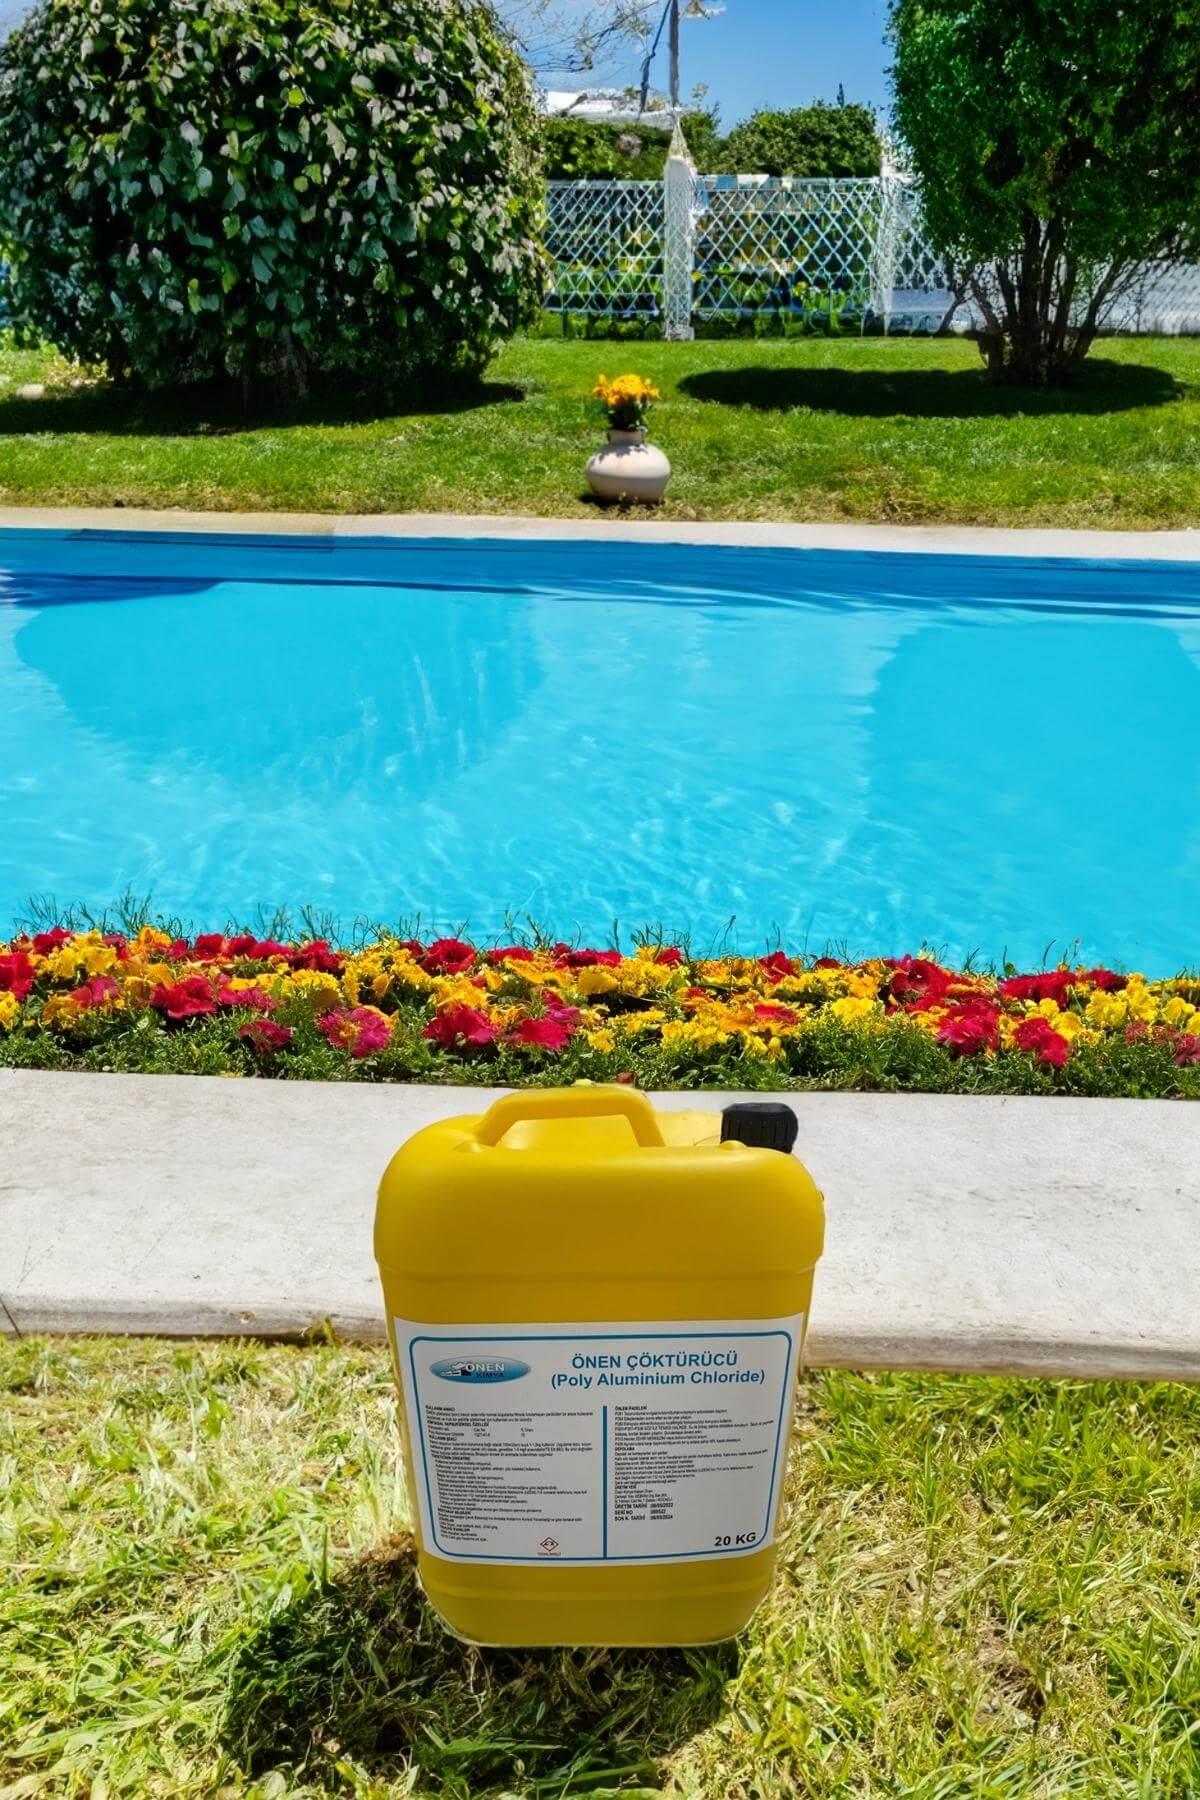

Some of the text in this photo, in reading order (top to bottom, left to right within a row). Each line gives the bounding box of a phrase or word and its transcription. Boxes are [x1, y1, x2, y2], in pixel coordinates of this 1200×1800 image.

[465, 1360, 505, 1372] ÖNEN
[571, 1350, 738, 1370] ÖNEN ÇÖKTÜRÜCÜ
[551, 1369, 765, 1389] (Poly Aluminium Chloride)
[714, 1531, 756, 1546] 20 KG
